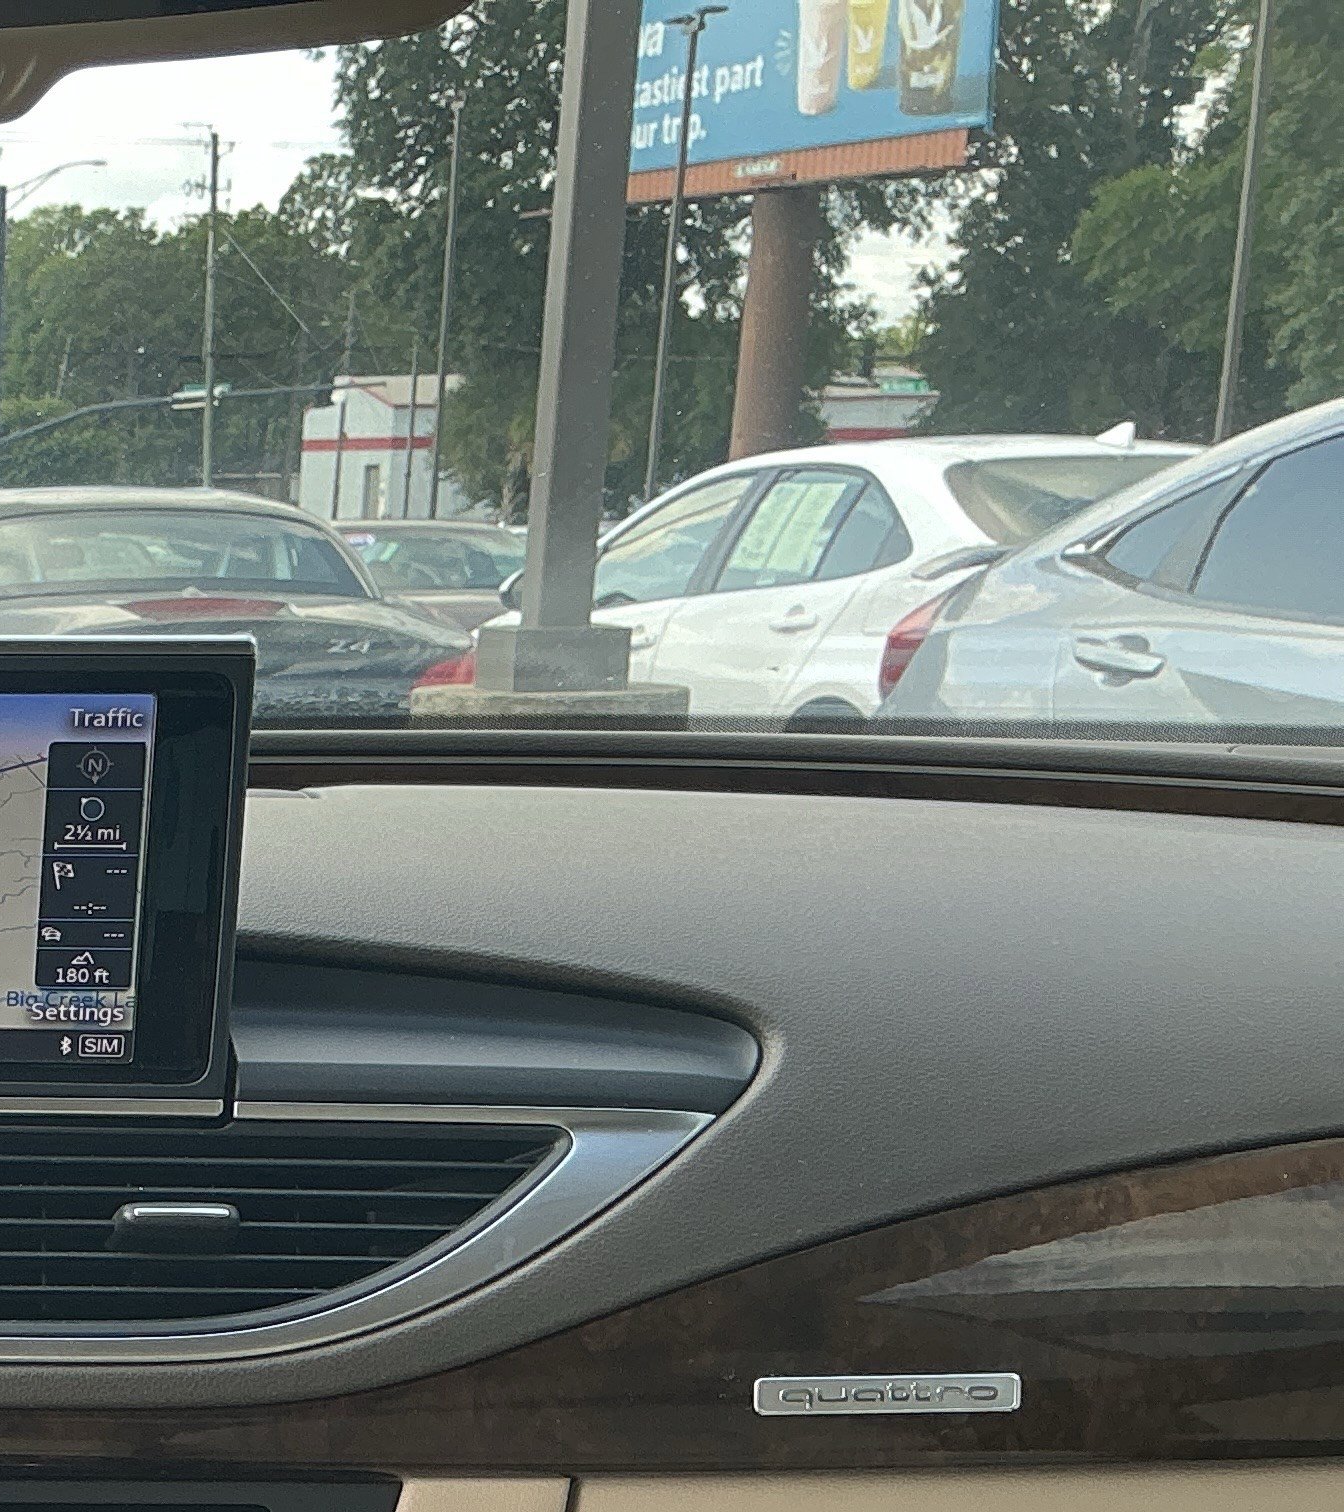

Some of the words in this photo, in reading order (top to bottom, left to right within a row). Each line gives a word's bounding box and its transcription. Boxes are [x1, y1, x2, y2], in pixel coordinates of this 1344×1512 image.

[715, 54, 764, 104] part
[630, 122, 658, 149] ur
[663, 114, 707, 149] trp.
[70, 707, 144, 727] Traffic
[88, 758, 102, 772] N
[98, 824, 120, 840] mi
[55, 968, 90, 983] 180
[94, 968, 110, 984] ft
[31, 1003, 125, 1026] Settings
[84, 1039, 118, 1052] SIM
[778, 1382, 999, 1410] quattro
